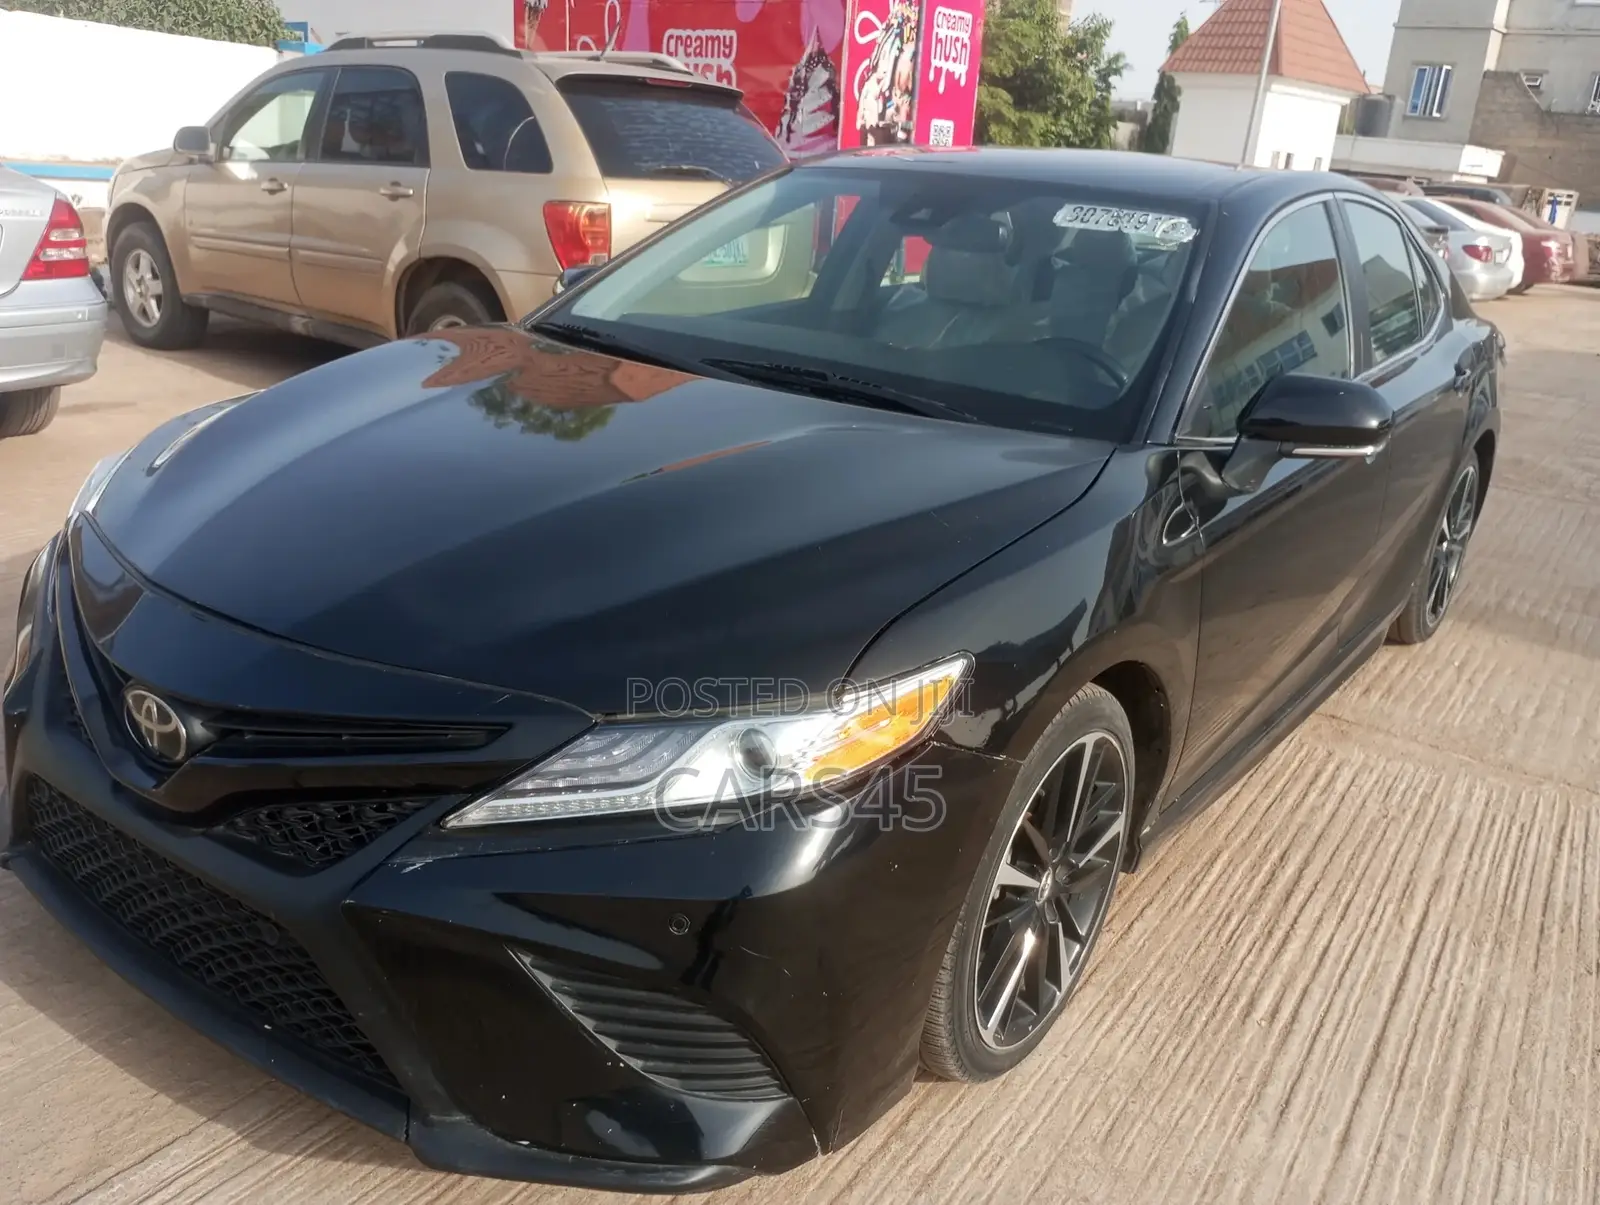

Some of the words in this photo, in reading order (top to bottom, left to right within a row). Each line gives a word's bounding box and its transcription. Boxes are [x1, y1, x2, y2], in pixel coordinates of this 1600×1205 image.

[936, 11, 971, 33] creamy
[666, 33, 733, 59] creamy
[933, 31, 968, 66] hush
